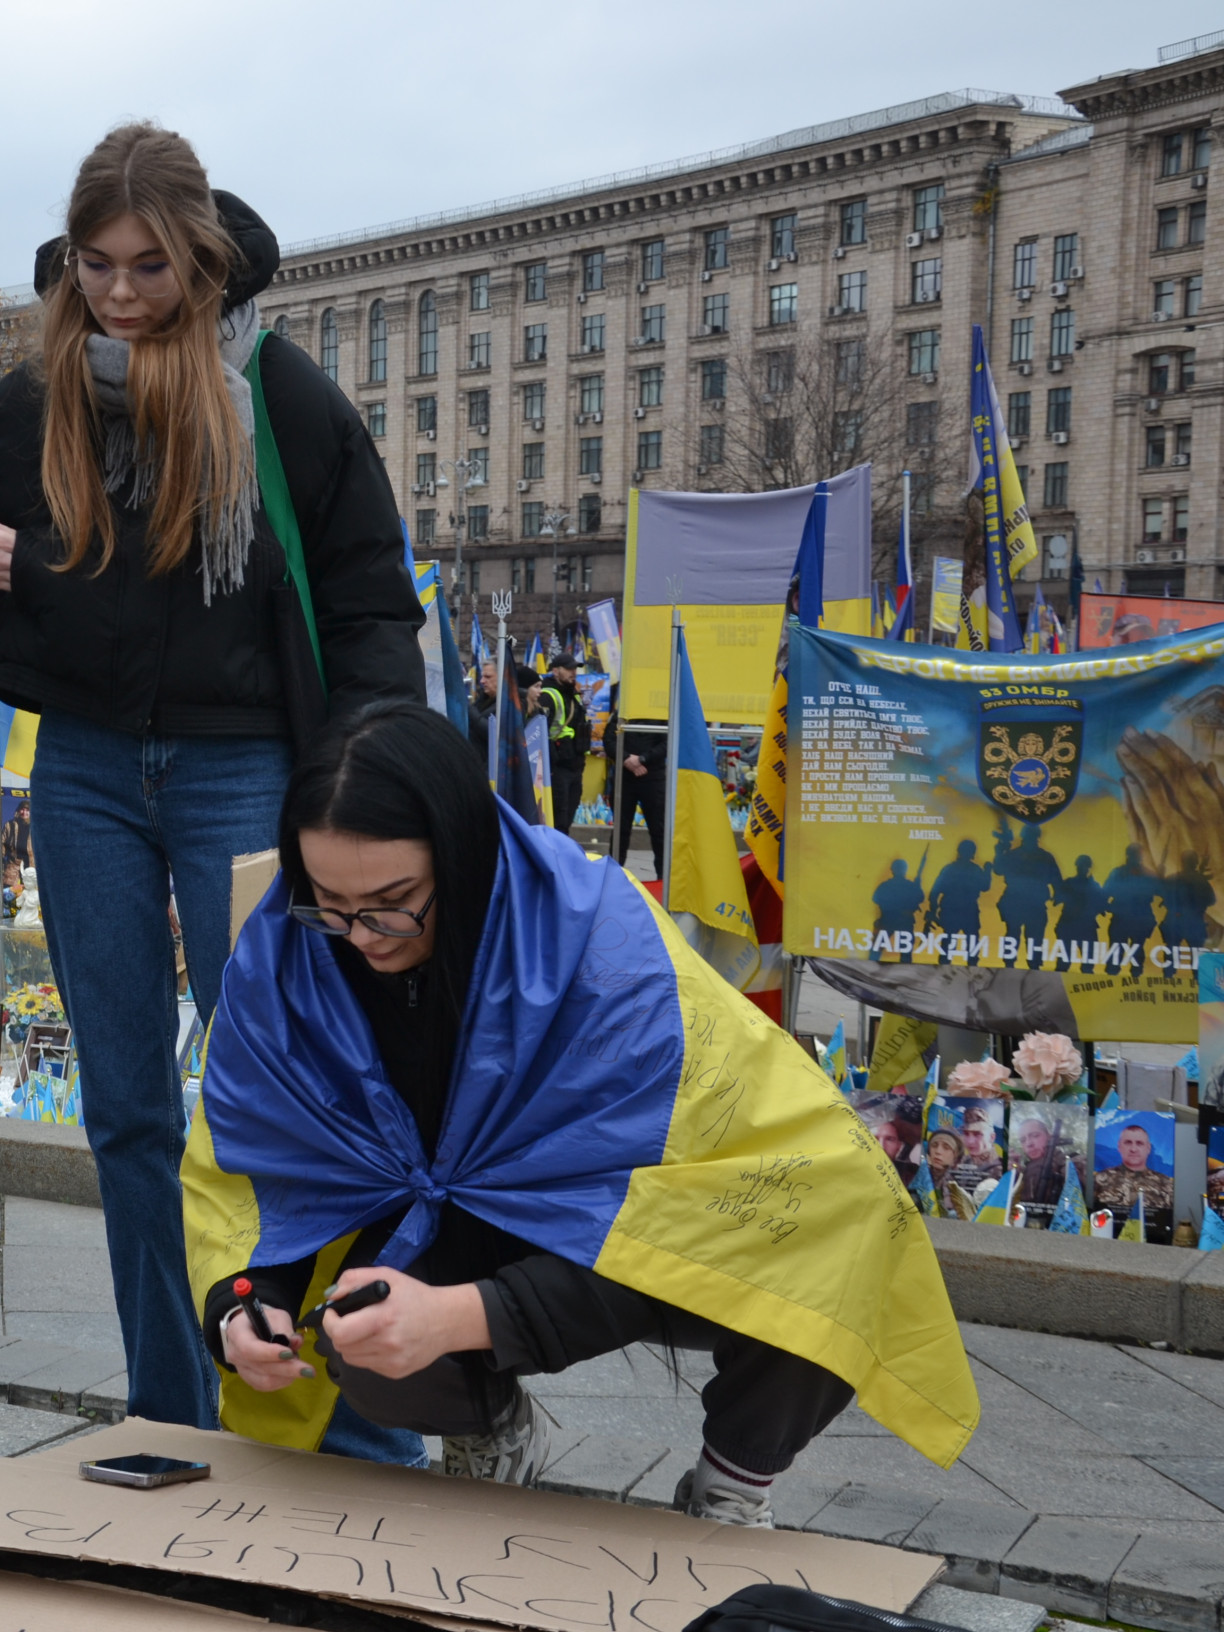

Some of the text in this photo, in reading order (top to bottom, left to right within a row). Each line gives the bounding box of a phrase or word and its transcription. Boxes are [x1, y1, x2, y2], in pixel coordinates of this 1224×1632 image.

[859, 652, 953, 680] ГЕРОЇ
[955, 665, 998, 682] НЕ
[828, 681, 852, 693] ОТЧЕ
[979, 685, 1069, 699] 53 ОМБр
[820, 696, 835, 706] ЩО
[856, 698, 867, 707] НА
[802, 708, 829, 718] НЕХАЙ
[833, 709, 876, 720] СВЯТИТЬСЯ
[802, 719, 829, 729] НЕХАЙ
[833, 719, 868, 730] ПРИЙДЕ
[871, 722, 903, 733] ЦАРСТВО
[802, 730, 829, 740] НЕХАЙ
[833, 730, 856, 740] БУДЕ
[860, 731, 881, 741] ВОЛЯ
[801, 741, 814, 750] ЯК
[817, 741, 828, 750] НА
[858, 741, 874, 750] ТАК
[885, 742, 896, 751] НА
[824, 751, 844, 760] НАШ
[801, 761, 819, 770] ДАЙ
[824, 762, 843, 770] НАМ
[809, 772, 841, 781] ПРОСТИ
[844, 773, 864, 781] НАМ
[801, 782, 813, 791] ЯК
[825, 783, 838, 791] МИ
[809, 803, 820, 812] НЕ
[857, 804, 874, 812] НАС
[801, 813, 817, 822] АЛЕ
[862, 814, 878, 823] НАС
[813, 926, 989, 961] НАЗАВЖДИ
[997, 936, 1018, 960] В
[1027, 938, 1140, 968] НАШИХ
[181, 1499, 417, 1548] ТЕЖ
